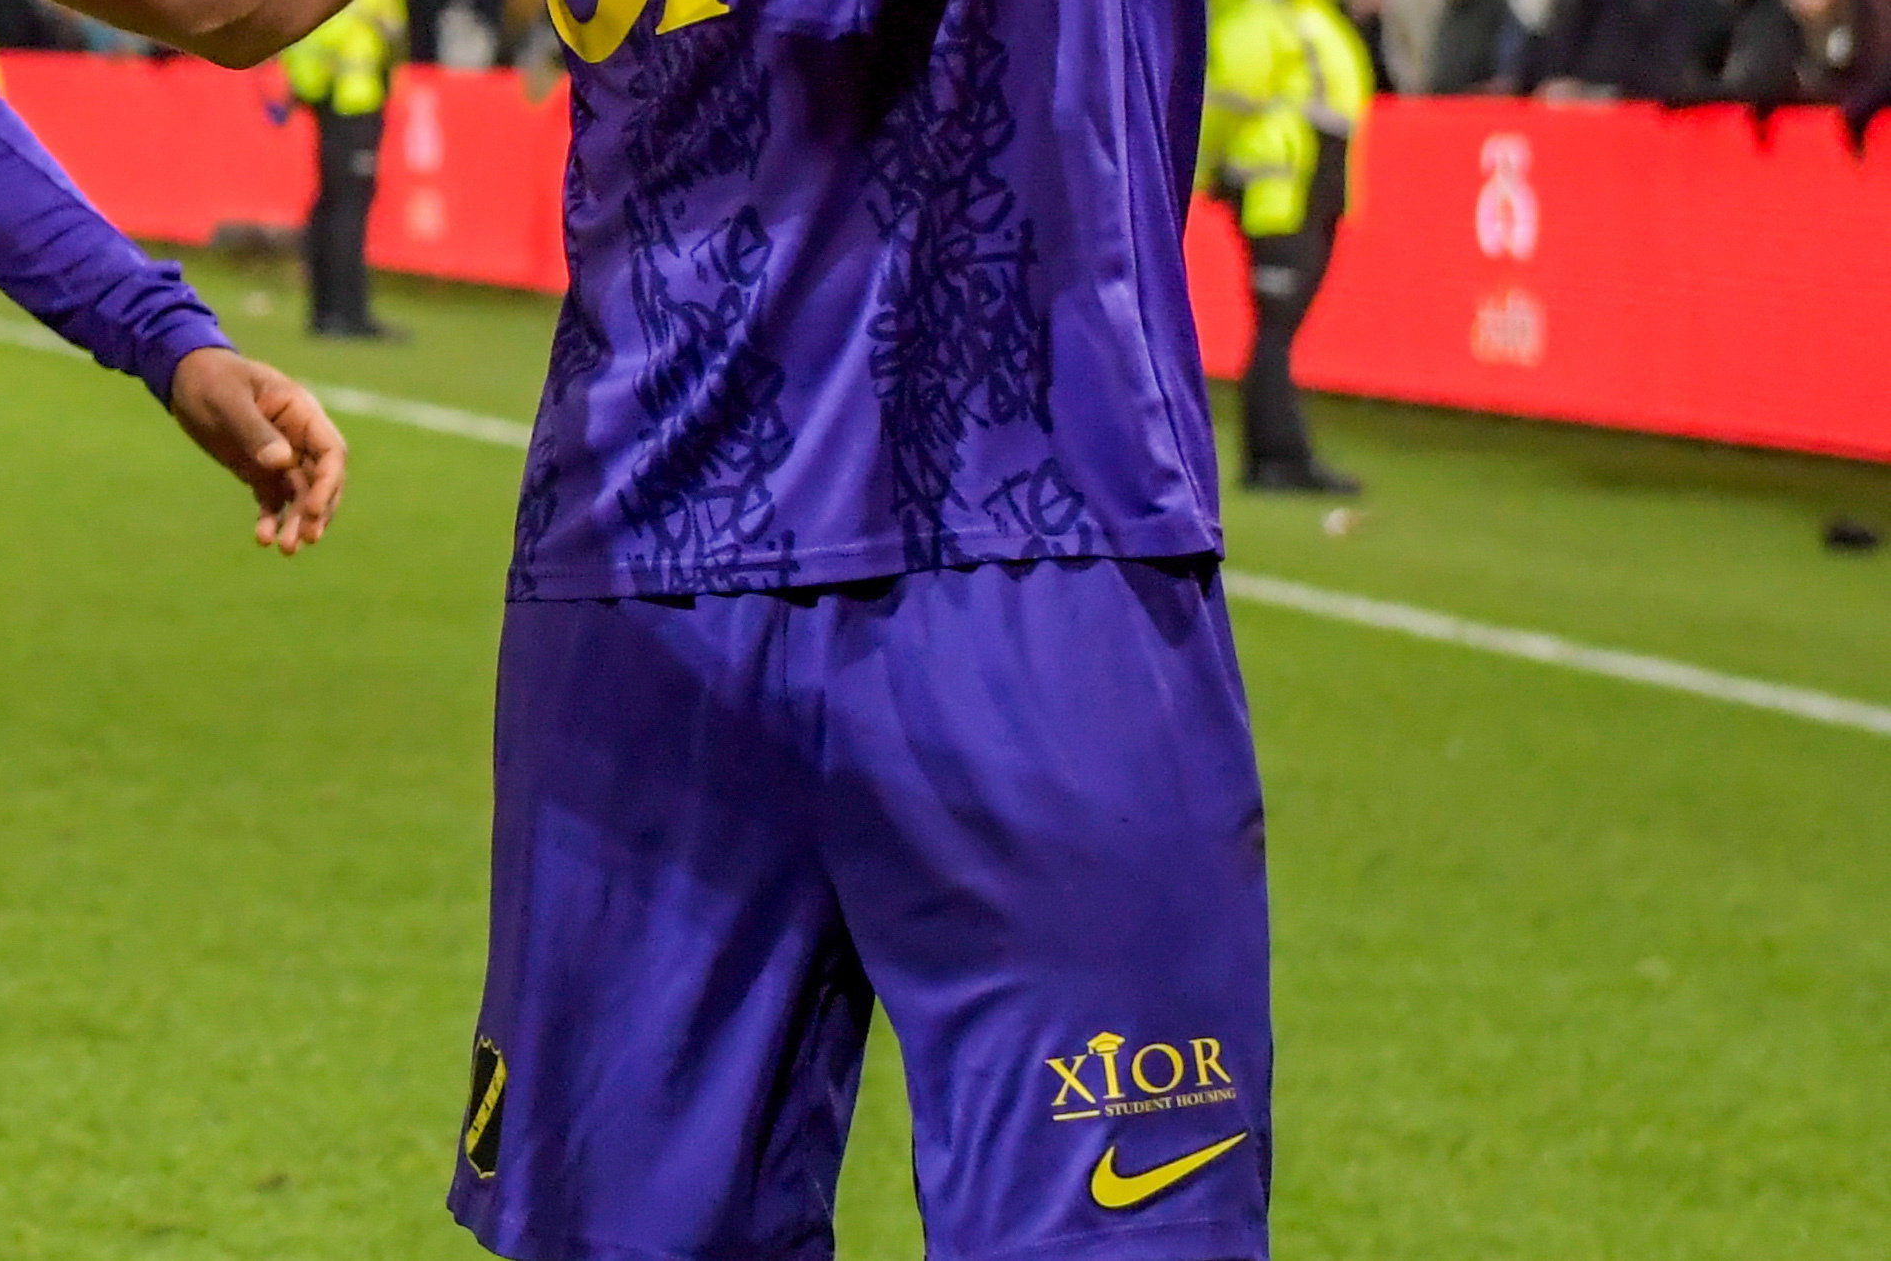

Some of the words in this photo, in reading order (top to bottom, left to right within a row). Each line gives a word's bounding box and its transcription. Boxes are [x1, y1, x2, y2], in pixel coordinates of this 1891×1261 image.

[1045, 1036, 1232, 1106] XIOR
[1105, 1096, 1172, 1117] STUDENT
[1176, 1087, 1237, 1108] HOUSING
